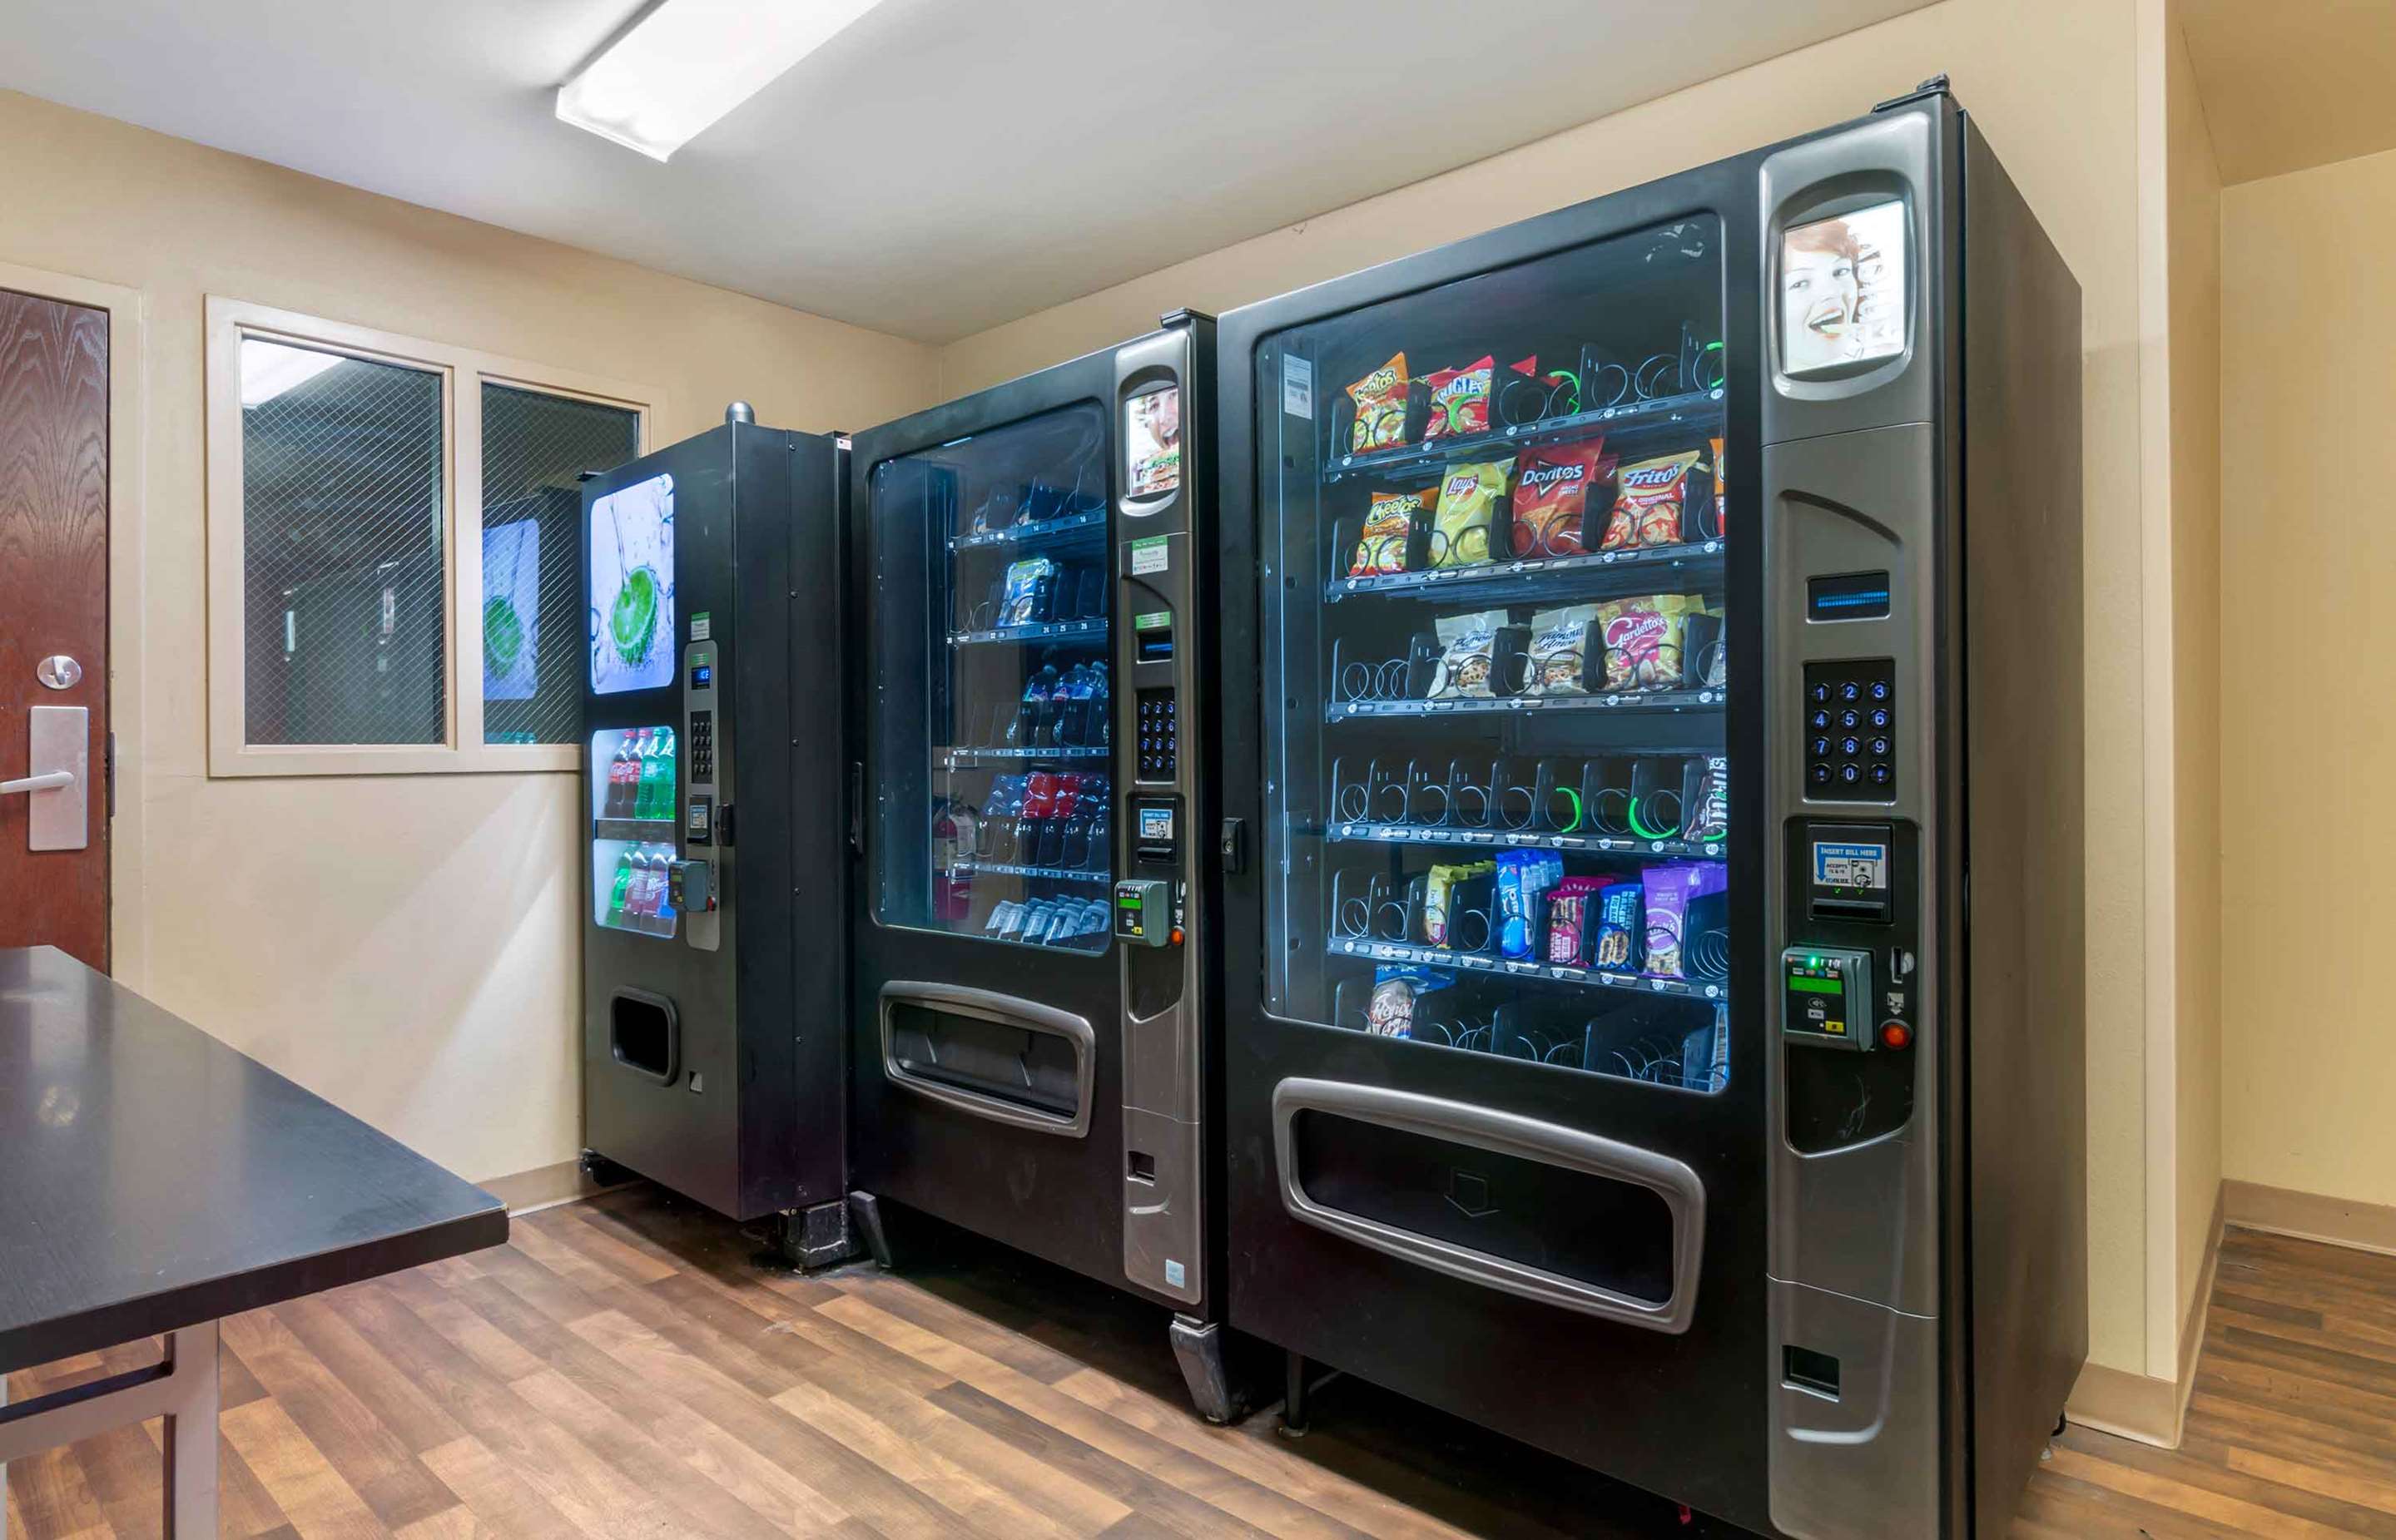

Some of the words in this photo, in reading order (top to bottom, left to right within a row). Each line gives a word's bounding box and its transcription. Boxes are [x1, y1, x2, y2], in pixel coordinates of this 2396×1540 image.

[1520, 464, 1585, 487] Doritos
[1624, 463, 1680, 487] Fritos
[1367, 494, 1421, 526] Cheetos
[1605, 616, 1670, 648] Gardetto's
[1818, 687, 1824, 700] 1
[1846, 686, 1855, 699] 2
[1874, 685, 1884, 698] 3
[1816, 713, 1825, 726] 4
[1845, 712, 1854, 726] 5
[1875, 712, 1885, 725] 6
[1817, 740, 1825, 754] 7
[1846, 740, 1854, 753] 8
[1875, 740, 1885, 754] 9
[1846, 768, 1854, 780] 0
